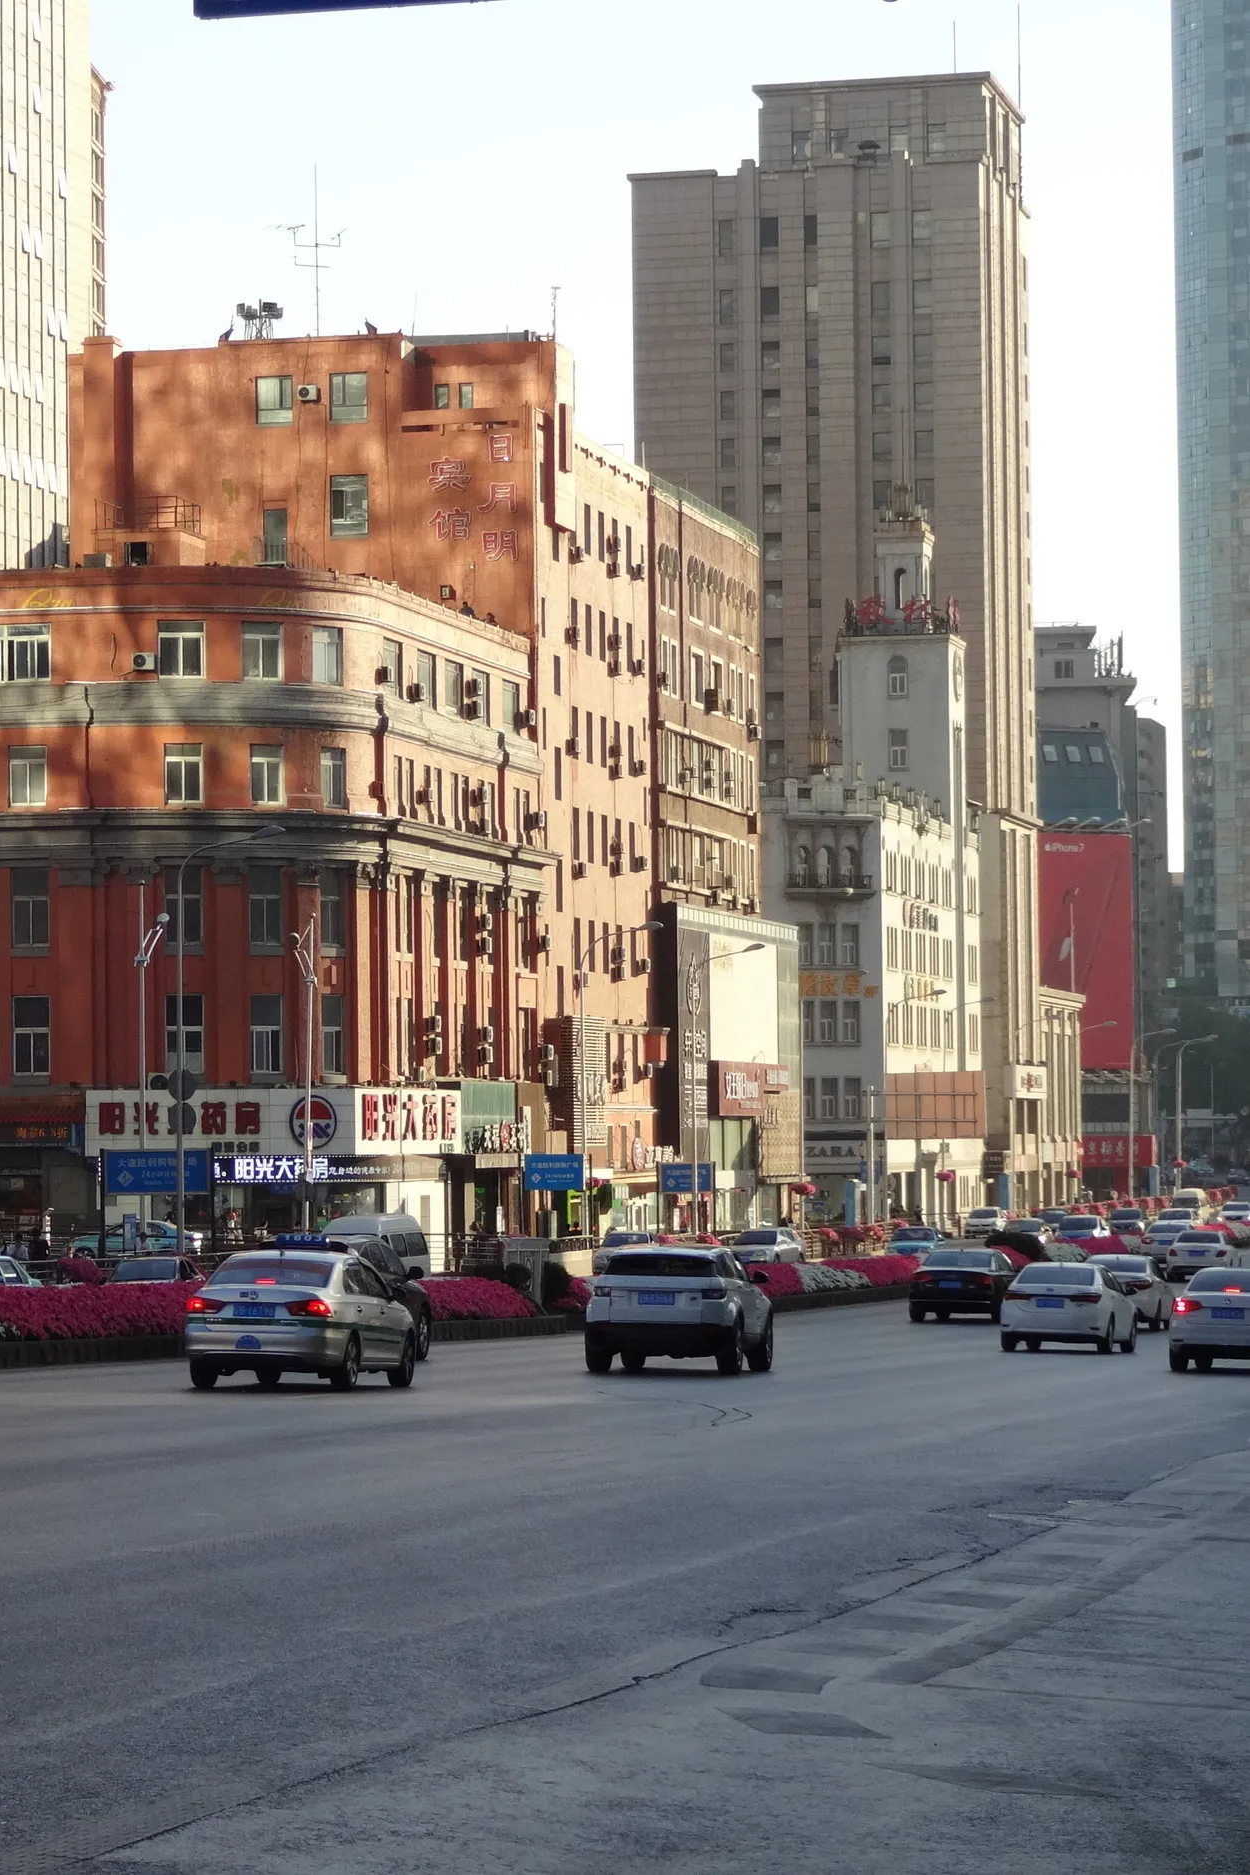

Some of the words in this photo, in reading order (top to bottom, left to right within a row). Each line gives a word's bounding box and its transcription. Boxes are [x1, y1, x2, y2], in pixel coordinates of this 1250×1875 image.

[427, 456, 472, 541] 宾馆
[1052, 842, 1078, 852] iPhone
[1079, 842, 1085, 852] 7
[98, 1101, 261, 1135] 阳光药房
[362, 1093, 457, 1141] 阳光大药房
[117, 1157, 199, 1169] 大连胜利购物场
[805, 1146, 857, 1158] ZARA
